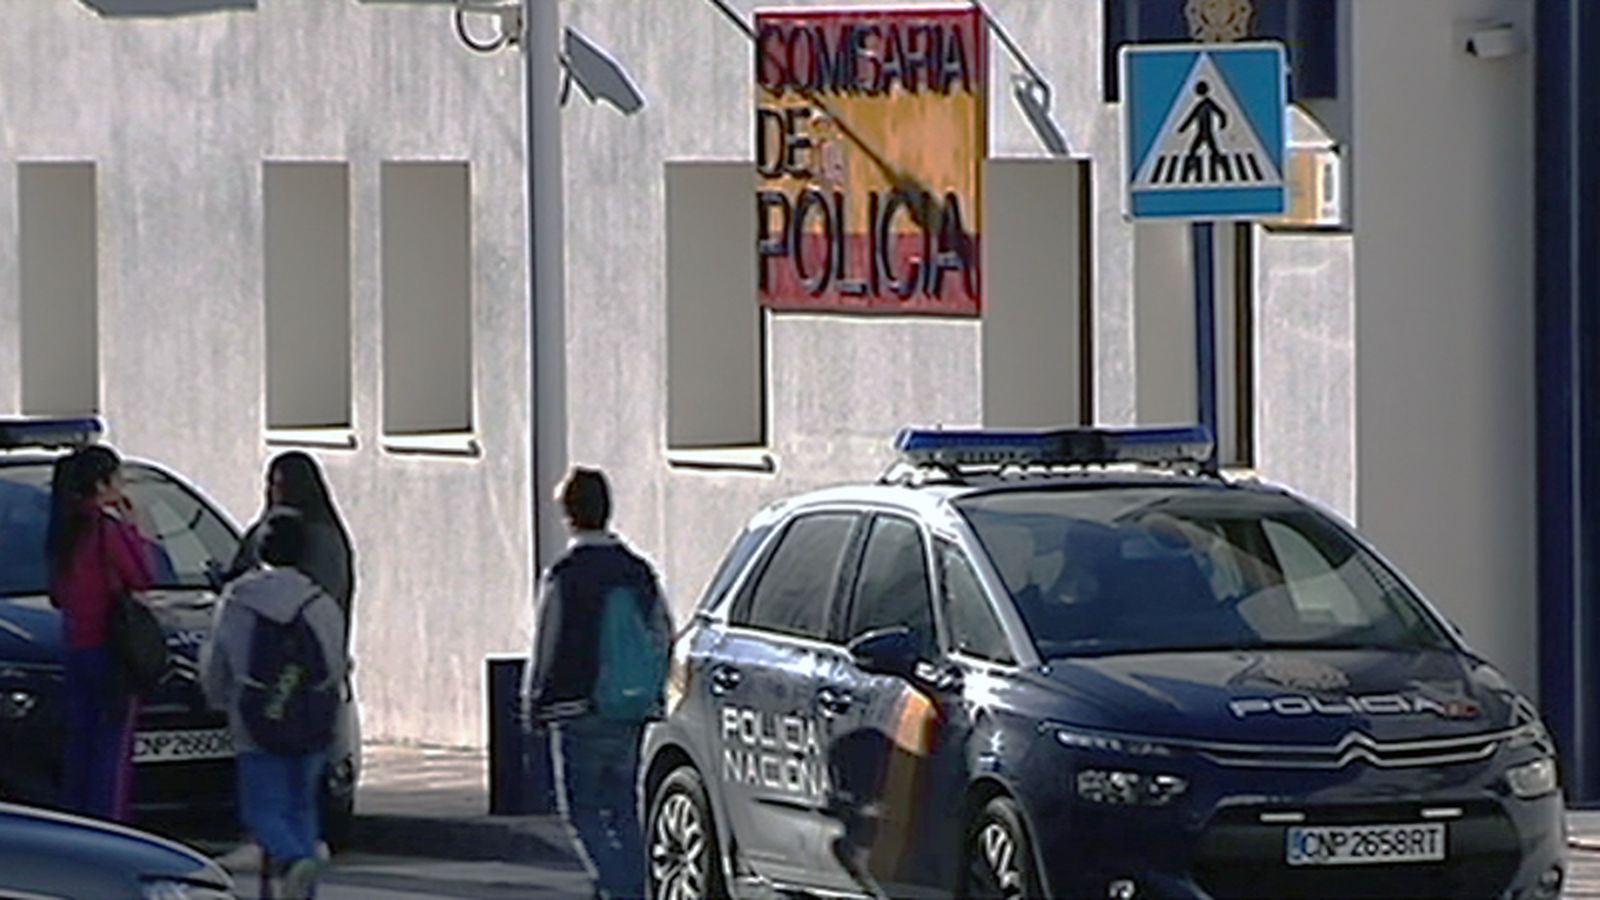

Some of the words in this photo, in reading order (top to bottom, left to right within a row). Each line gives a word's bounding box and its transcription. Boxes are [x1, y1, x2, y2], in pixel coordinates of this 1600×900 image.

[757, 107, 812, 178] DE
[757, 190, 975, 300] POLICIA
[1229, 693, 1447, 718] POLICIA
